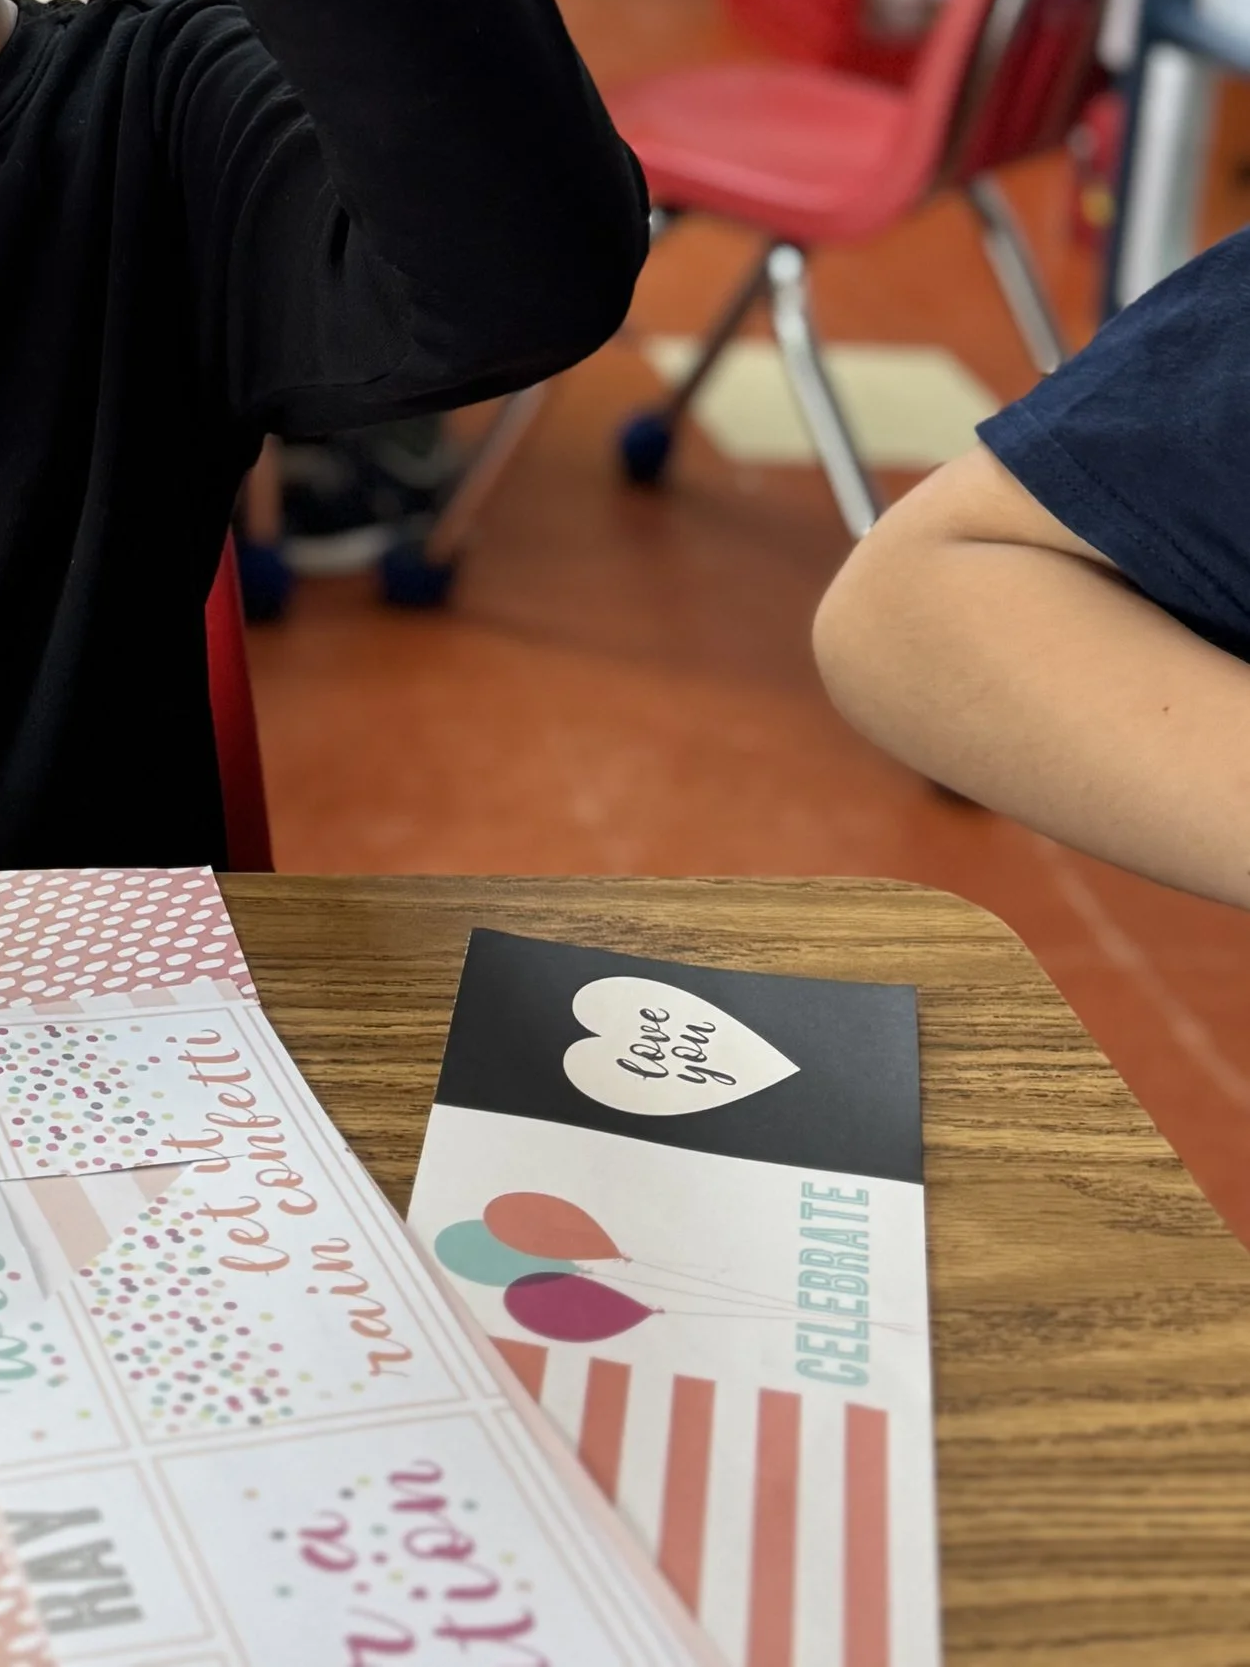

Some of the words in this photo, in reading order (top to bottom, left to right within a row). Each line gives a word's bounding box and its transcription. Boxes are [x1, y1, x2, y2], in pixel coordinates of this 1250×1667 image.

[616, 1007, 671, 1080] love
[670, 1022, 737, 1086] you
[165, 1028, 319, 1216] confetti
[195, 1196, 291, 1276] let
[795, 1180, 870, 1387] CELEBRATE
[305, 1237, 414, 1378] rain
[386, 1458, 551, 1667] tion
